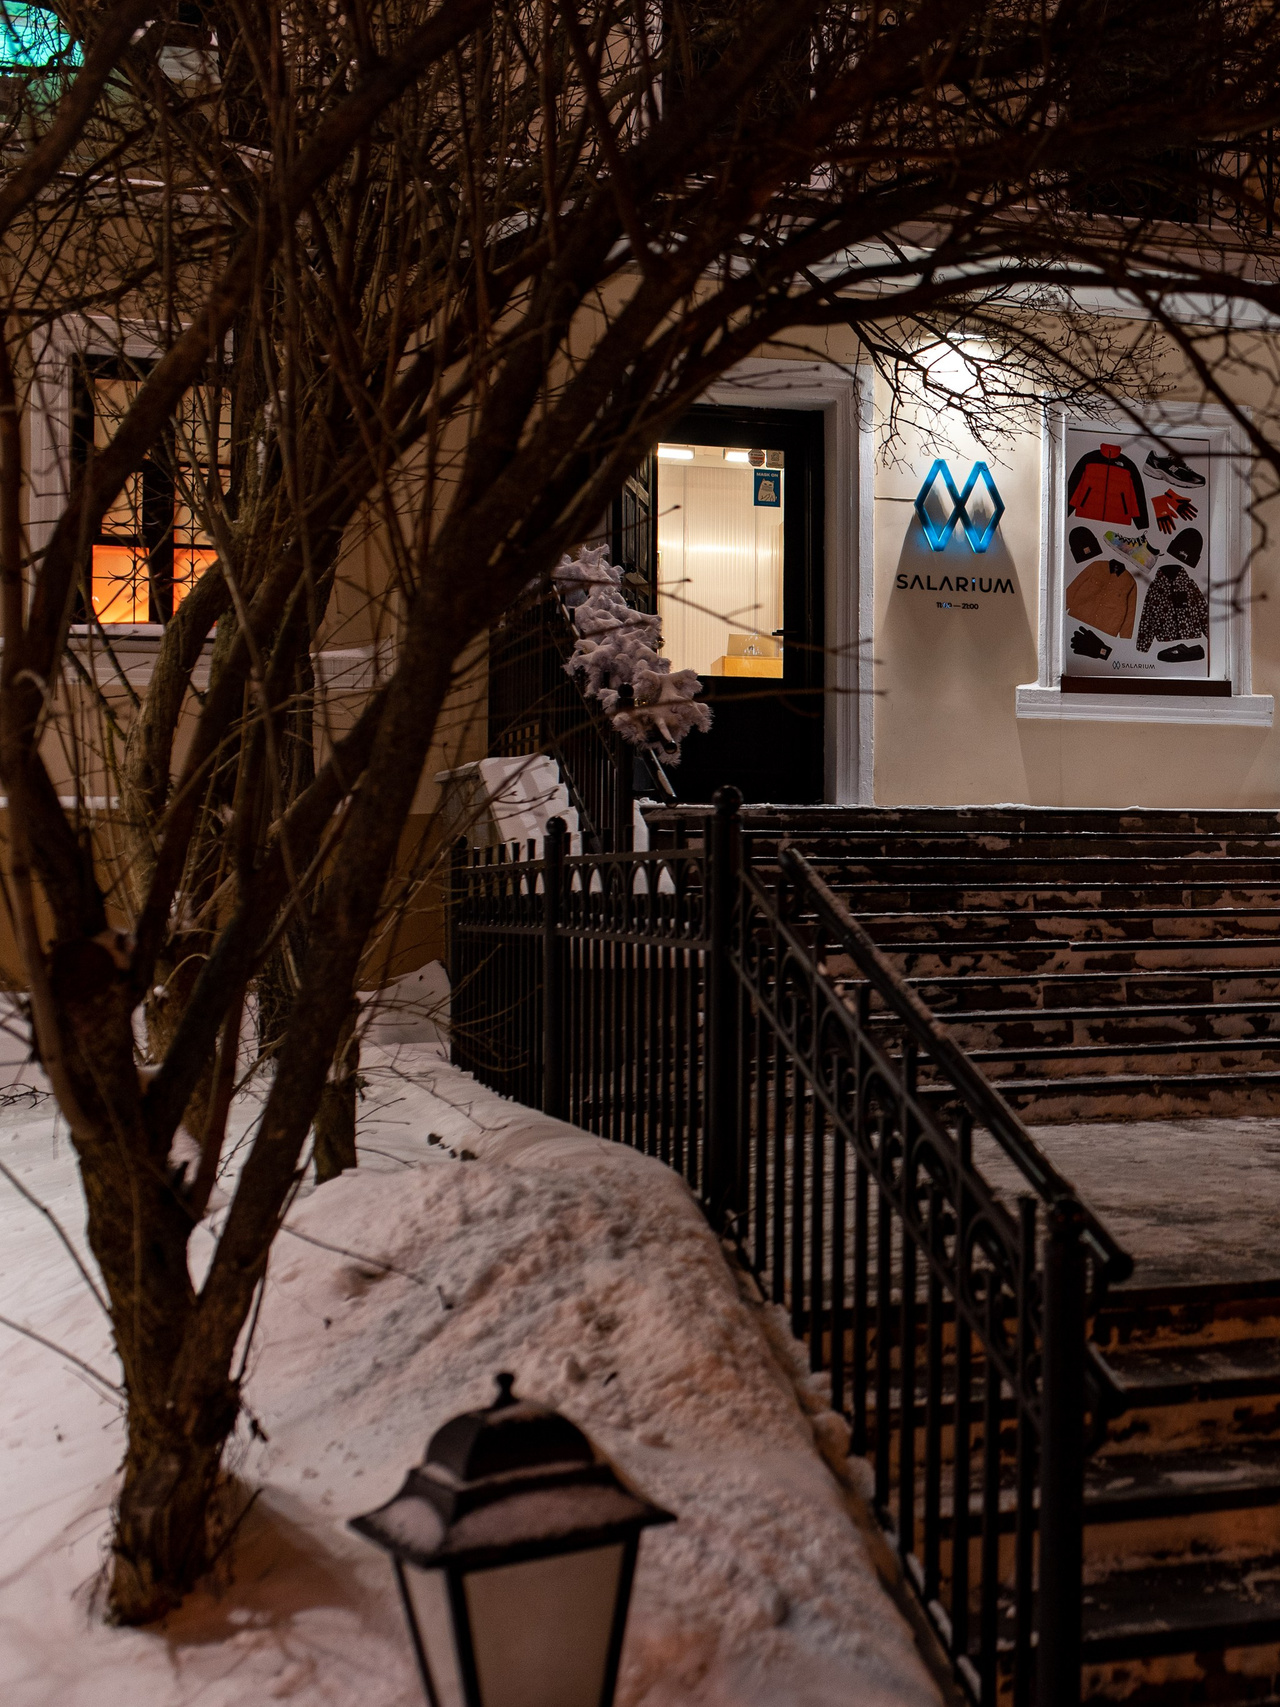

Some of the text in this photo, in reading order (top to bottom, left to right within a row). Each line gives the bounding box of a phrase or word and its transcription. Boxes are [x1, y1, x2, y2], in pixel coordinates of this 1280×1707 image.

[896, 573, 1015, 594] SALARIUM
[961, 602, 979, 610] 21:00
[1121, 662, 1156, 670] SALARIUM
